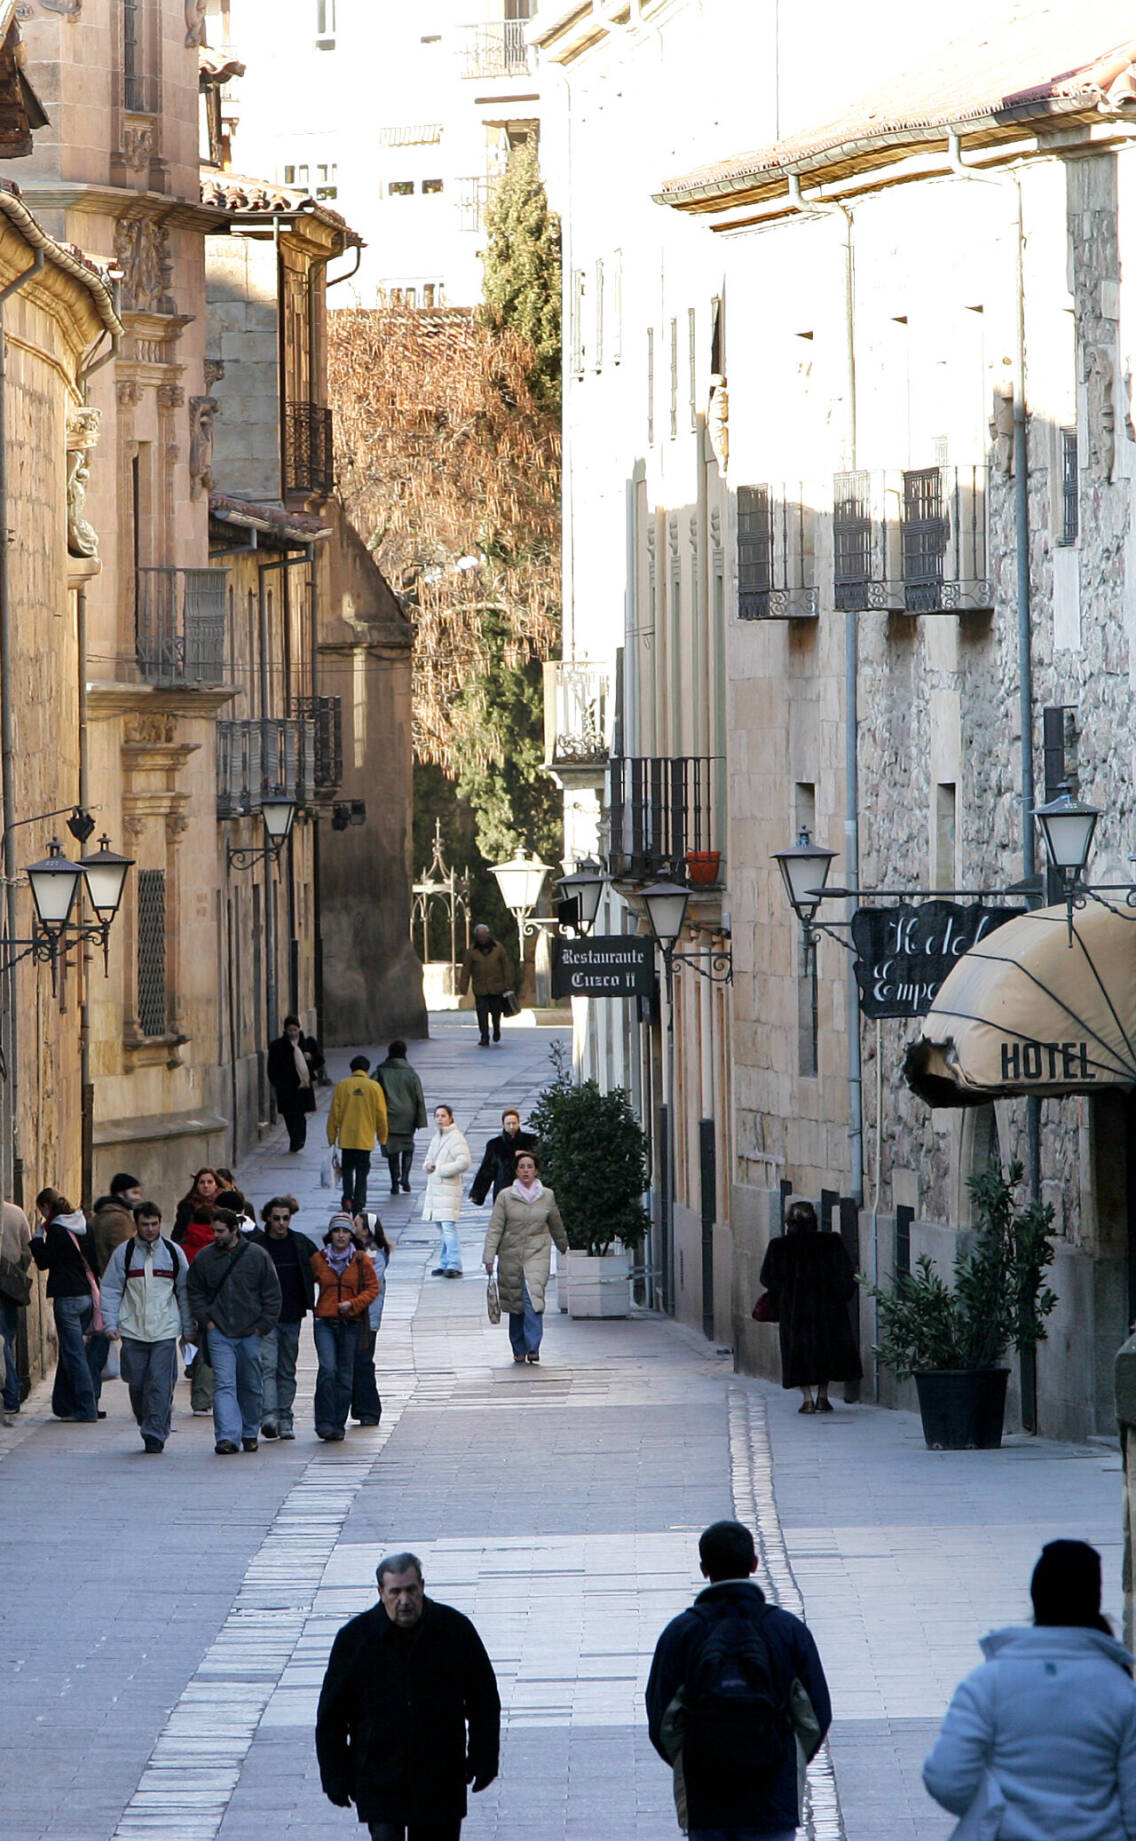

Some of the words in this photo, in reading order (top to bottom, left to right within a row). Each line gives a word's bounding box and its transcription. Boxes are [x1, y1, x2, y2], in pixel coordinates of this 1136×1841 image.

[561, 949, 645, 965] Restaurante
[571, 972, 620, 988] Cuzco
[1000, 1042, 1096, 1080] HOTEL
